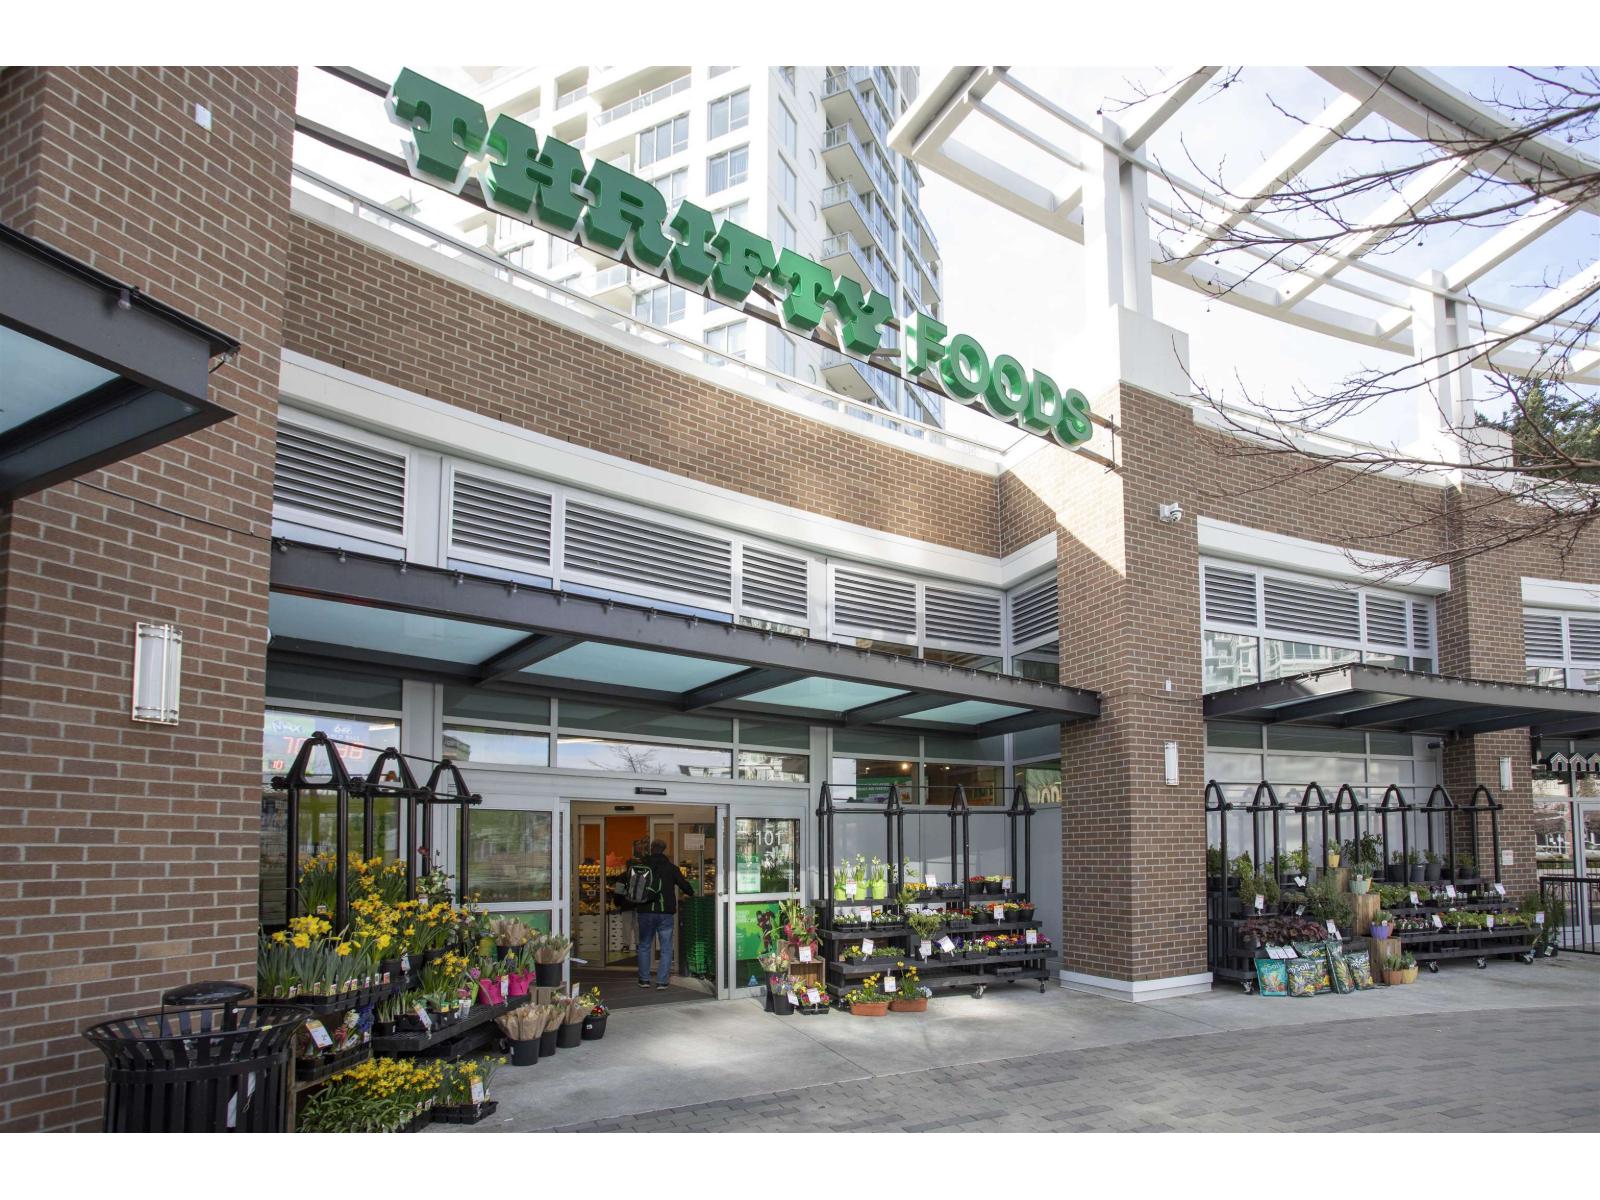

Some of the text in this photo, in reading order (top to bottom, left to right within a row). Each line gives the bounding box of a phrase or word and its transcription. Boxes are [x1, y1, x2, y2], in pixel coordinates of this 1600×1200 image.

[385, 68, 1093, 449] THRIFTY FOODS
[756, 830, 782, 846] 101
